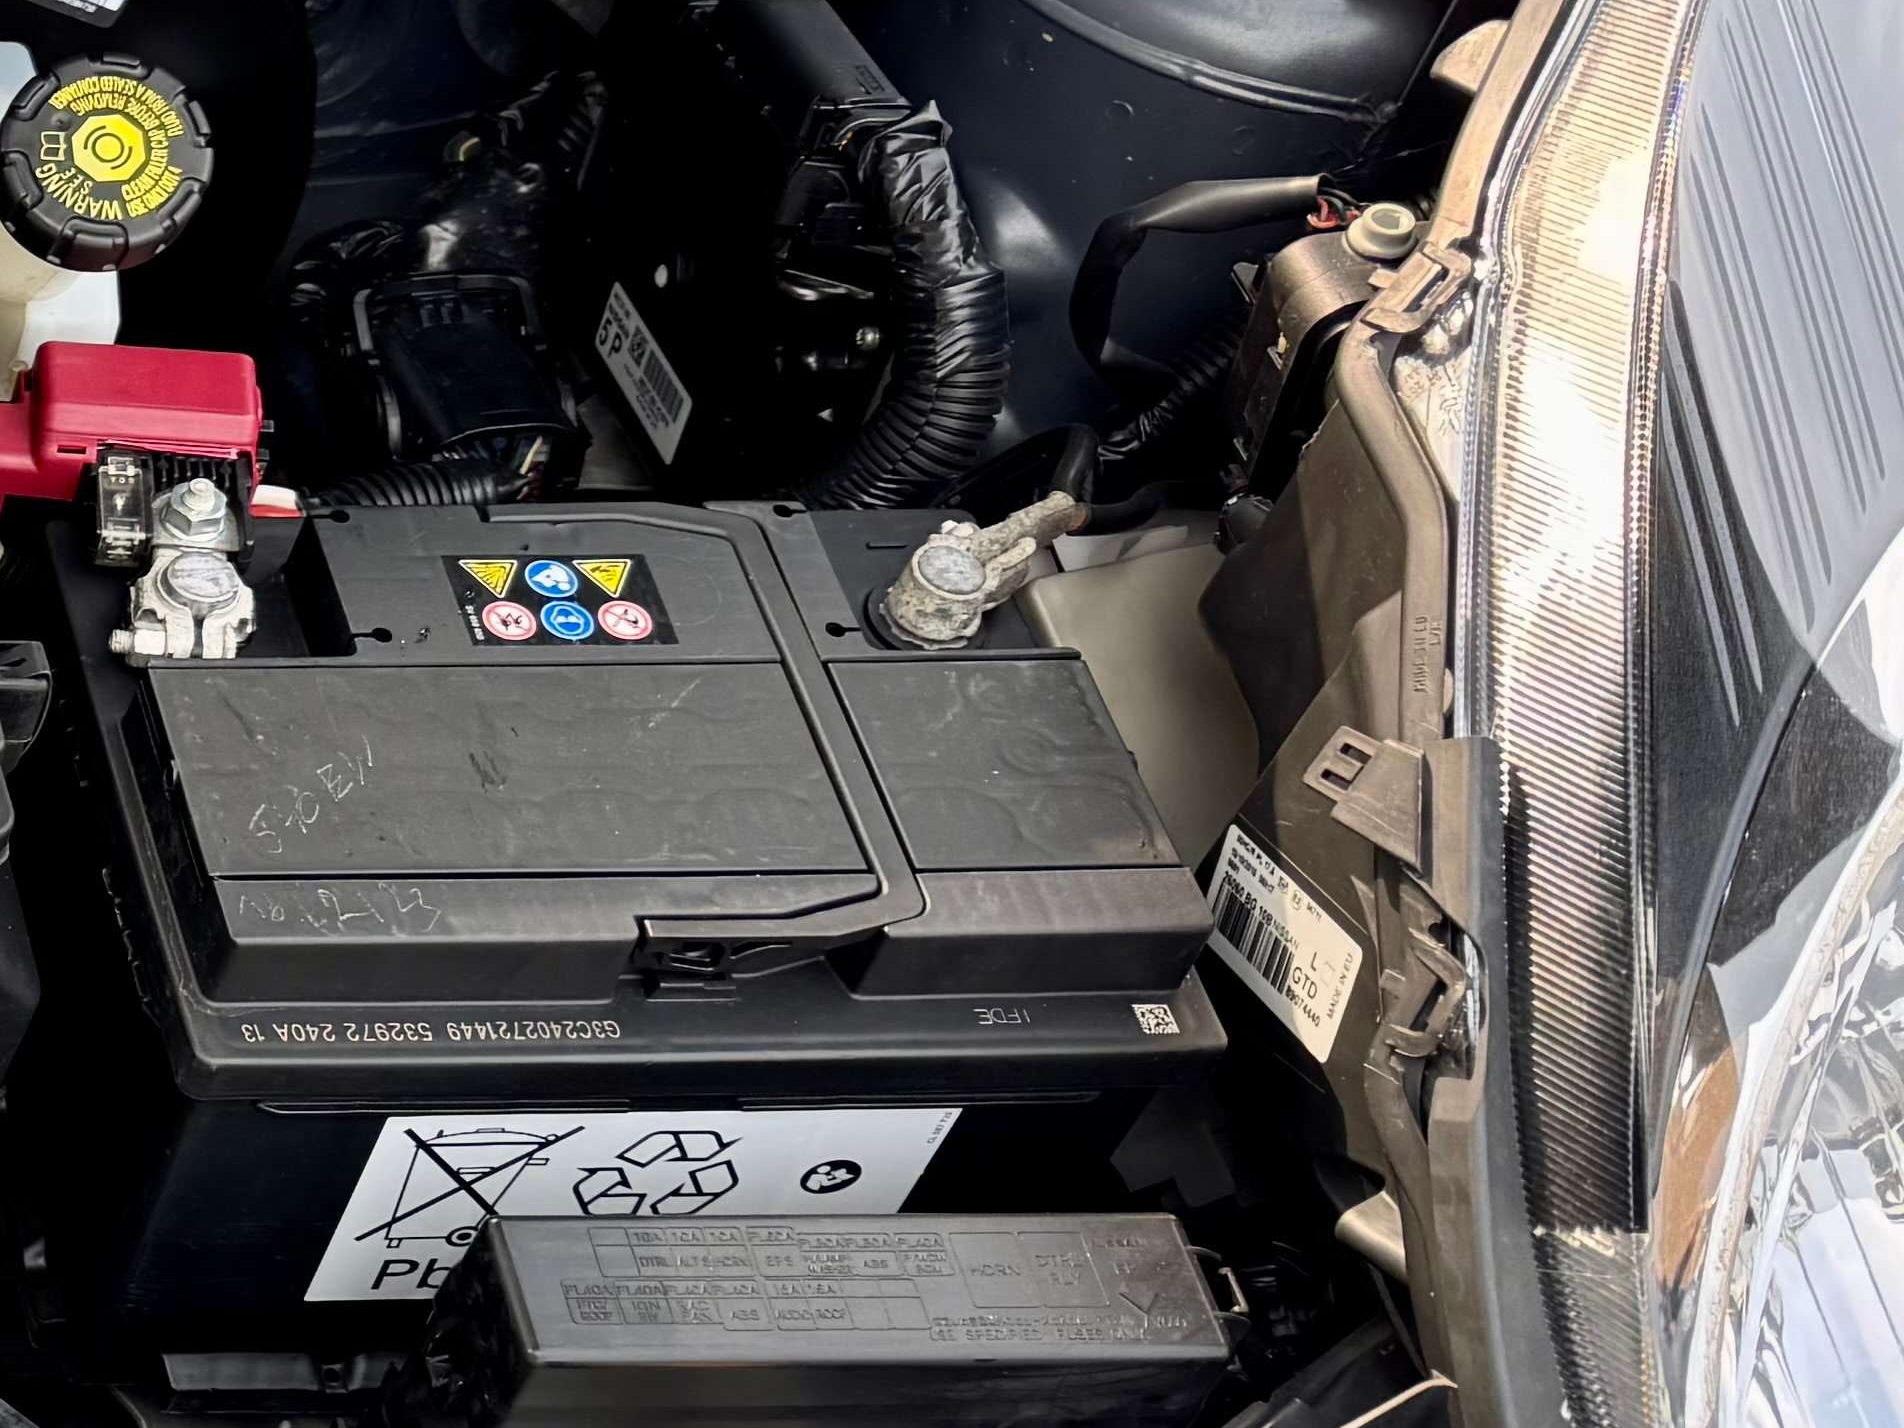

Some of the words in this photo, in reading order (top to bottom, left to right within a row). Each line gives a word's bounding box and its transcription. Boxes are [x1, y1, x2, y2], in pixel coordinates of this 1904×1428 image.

[35, 163, 123, 220] WARNING
[60, 167, 93, 194] SEE
[1292, 966, 1318, 1000] GTD
[239, 1022, 265, 1043] 13
[271, 1021, 335, 1043] 240A
[342, 1019, 434, 1042] 532972
[445, 1018, 622, 1042] G3C2402721449
[371, 1258, 454, 1290] Pb
[970, 1263, 1021, 1276] HORN
[965, 1328, 1042, 1341] SPECIFIED
